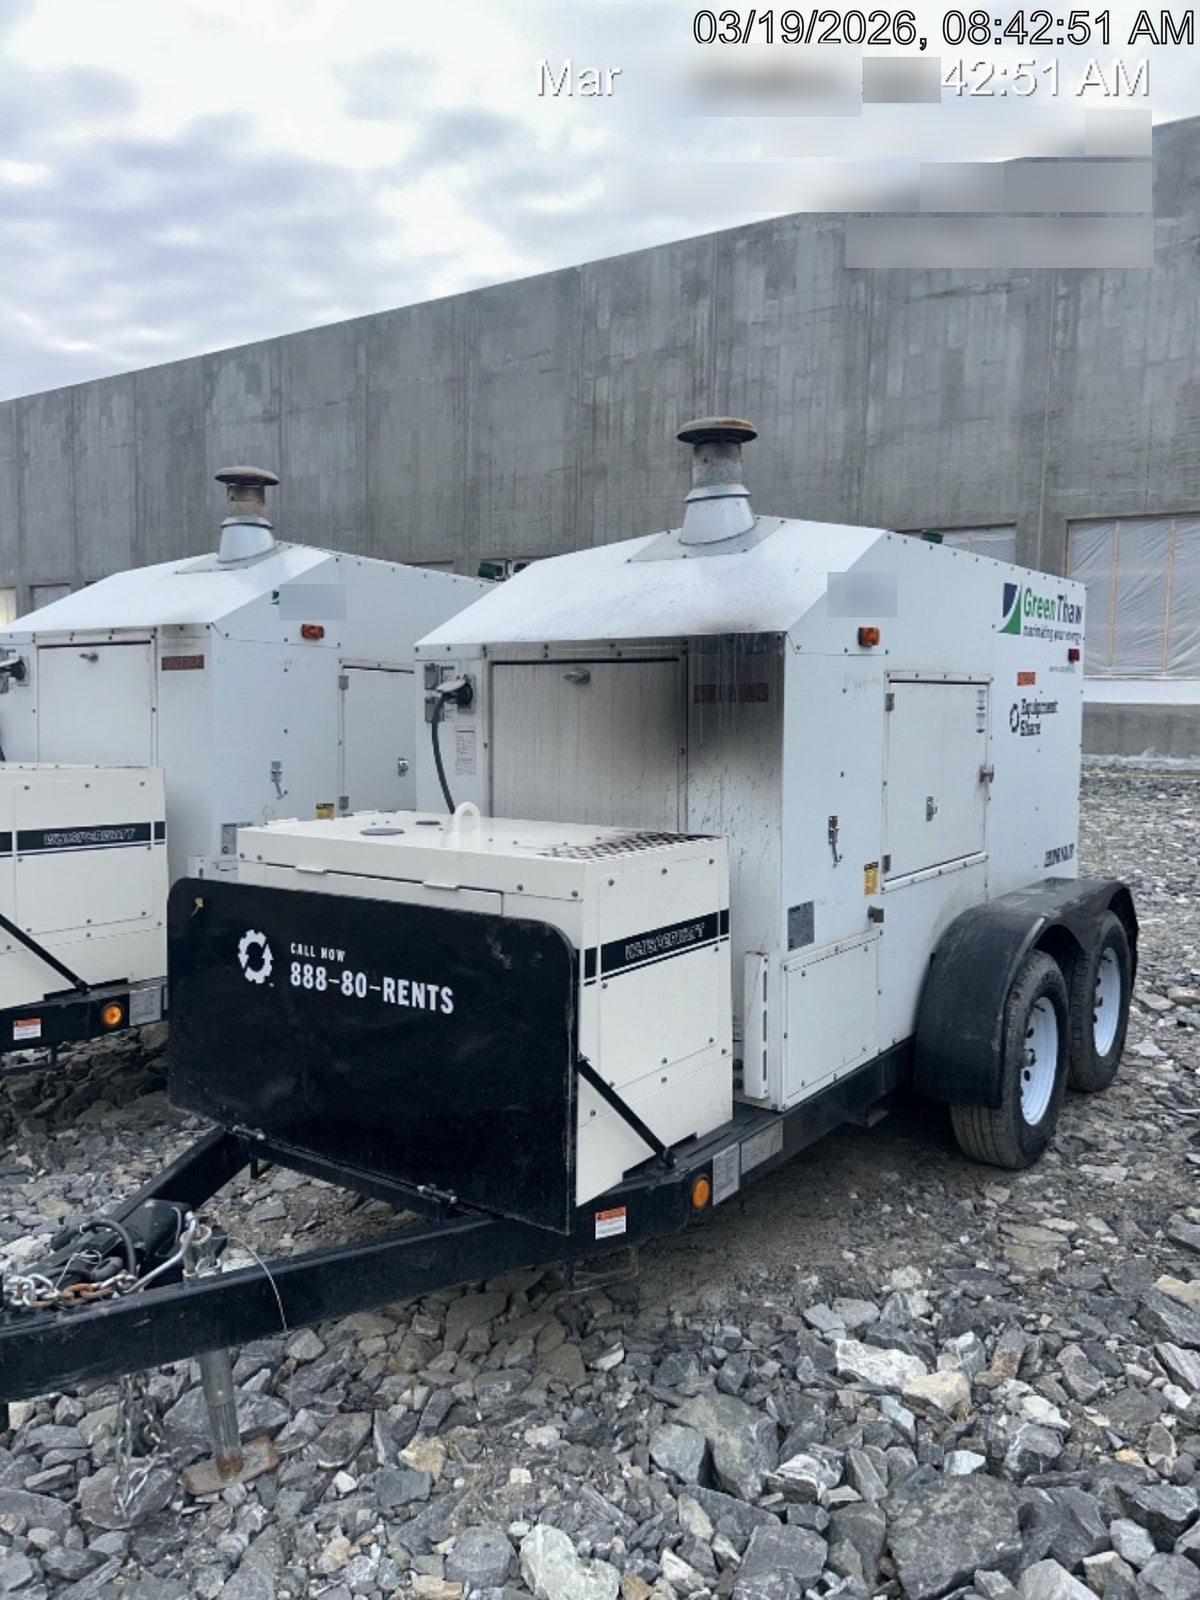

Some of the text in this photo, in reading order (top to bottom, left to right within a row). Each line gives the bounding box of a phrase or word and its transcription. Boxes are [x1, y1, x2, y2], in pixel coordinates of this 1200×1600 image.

[1020, 719, 1041, 736] Share
[290, 943, 346, 962] CALL NOW
[290, 962, 454, 1015] 888-80-RENTS
